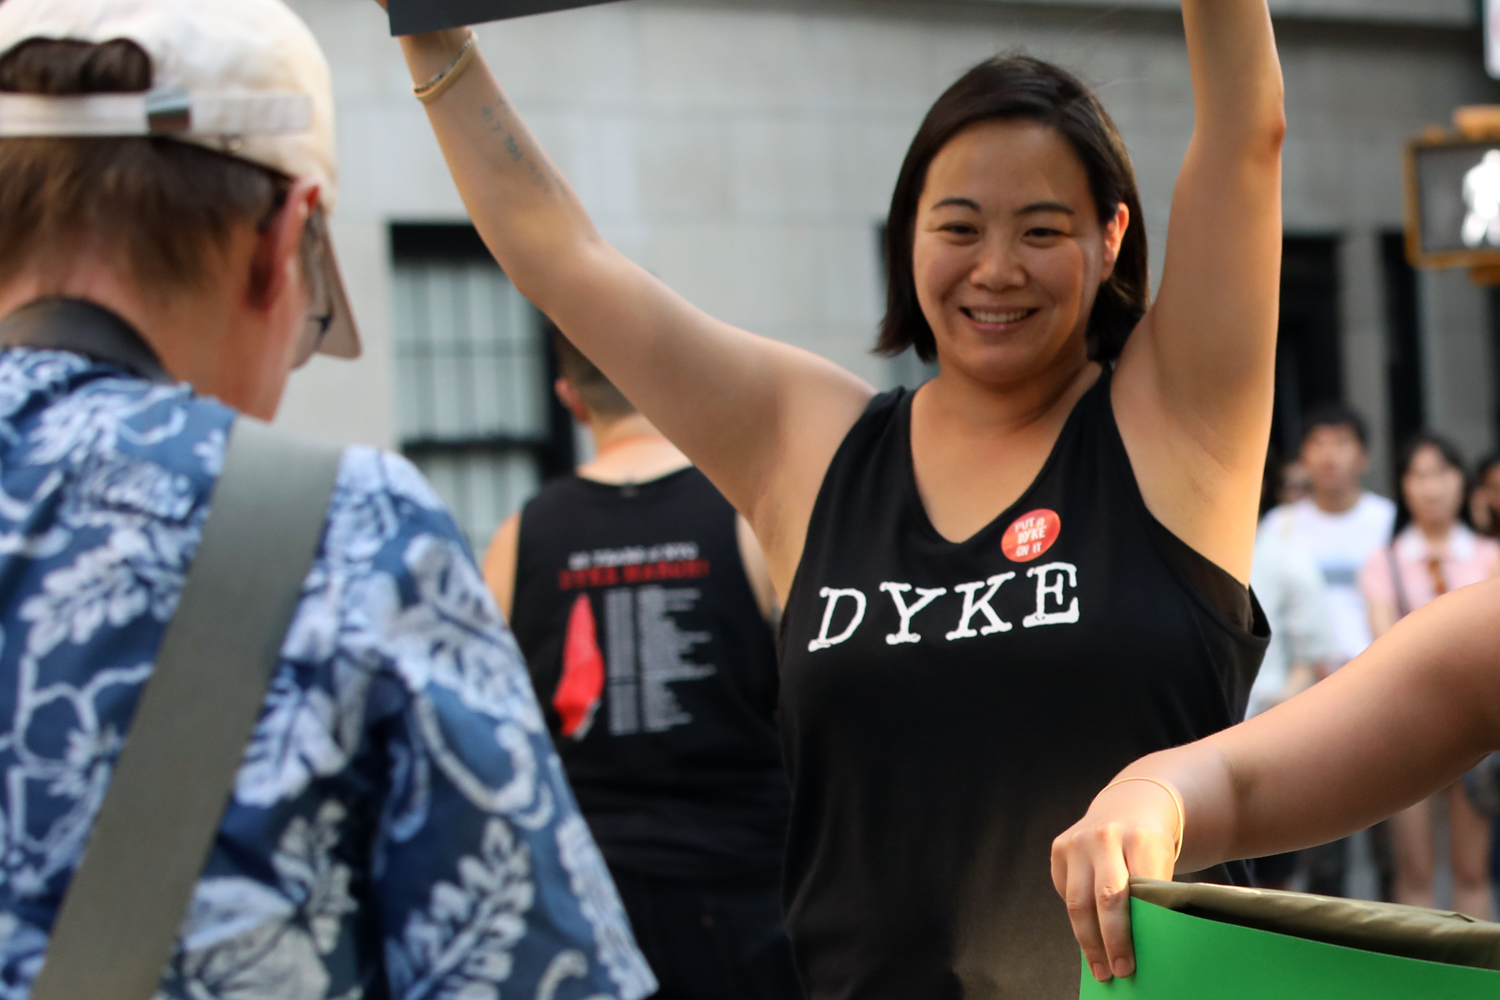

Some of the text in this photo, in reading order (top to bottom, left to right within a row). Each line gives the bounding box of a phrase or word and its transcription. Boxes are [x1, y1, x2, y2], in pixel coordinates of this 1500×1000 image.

[1015, 517, 1035, 532] PUT
[1017, 526, 1046, 545] DYKE
[1016, 542, 1042, 557] ON IT
[808, 562, 1079, 652] DYKE
